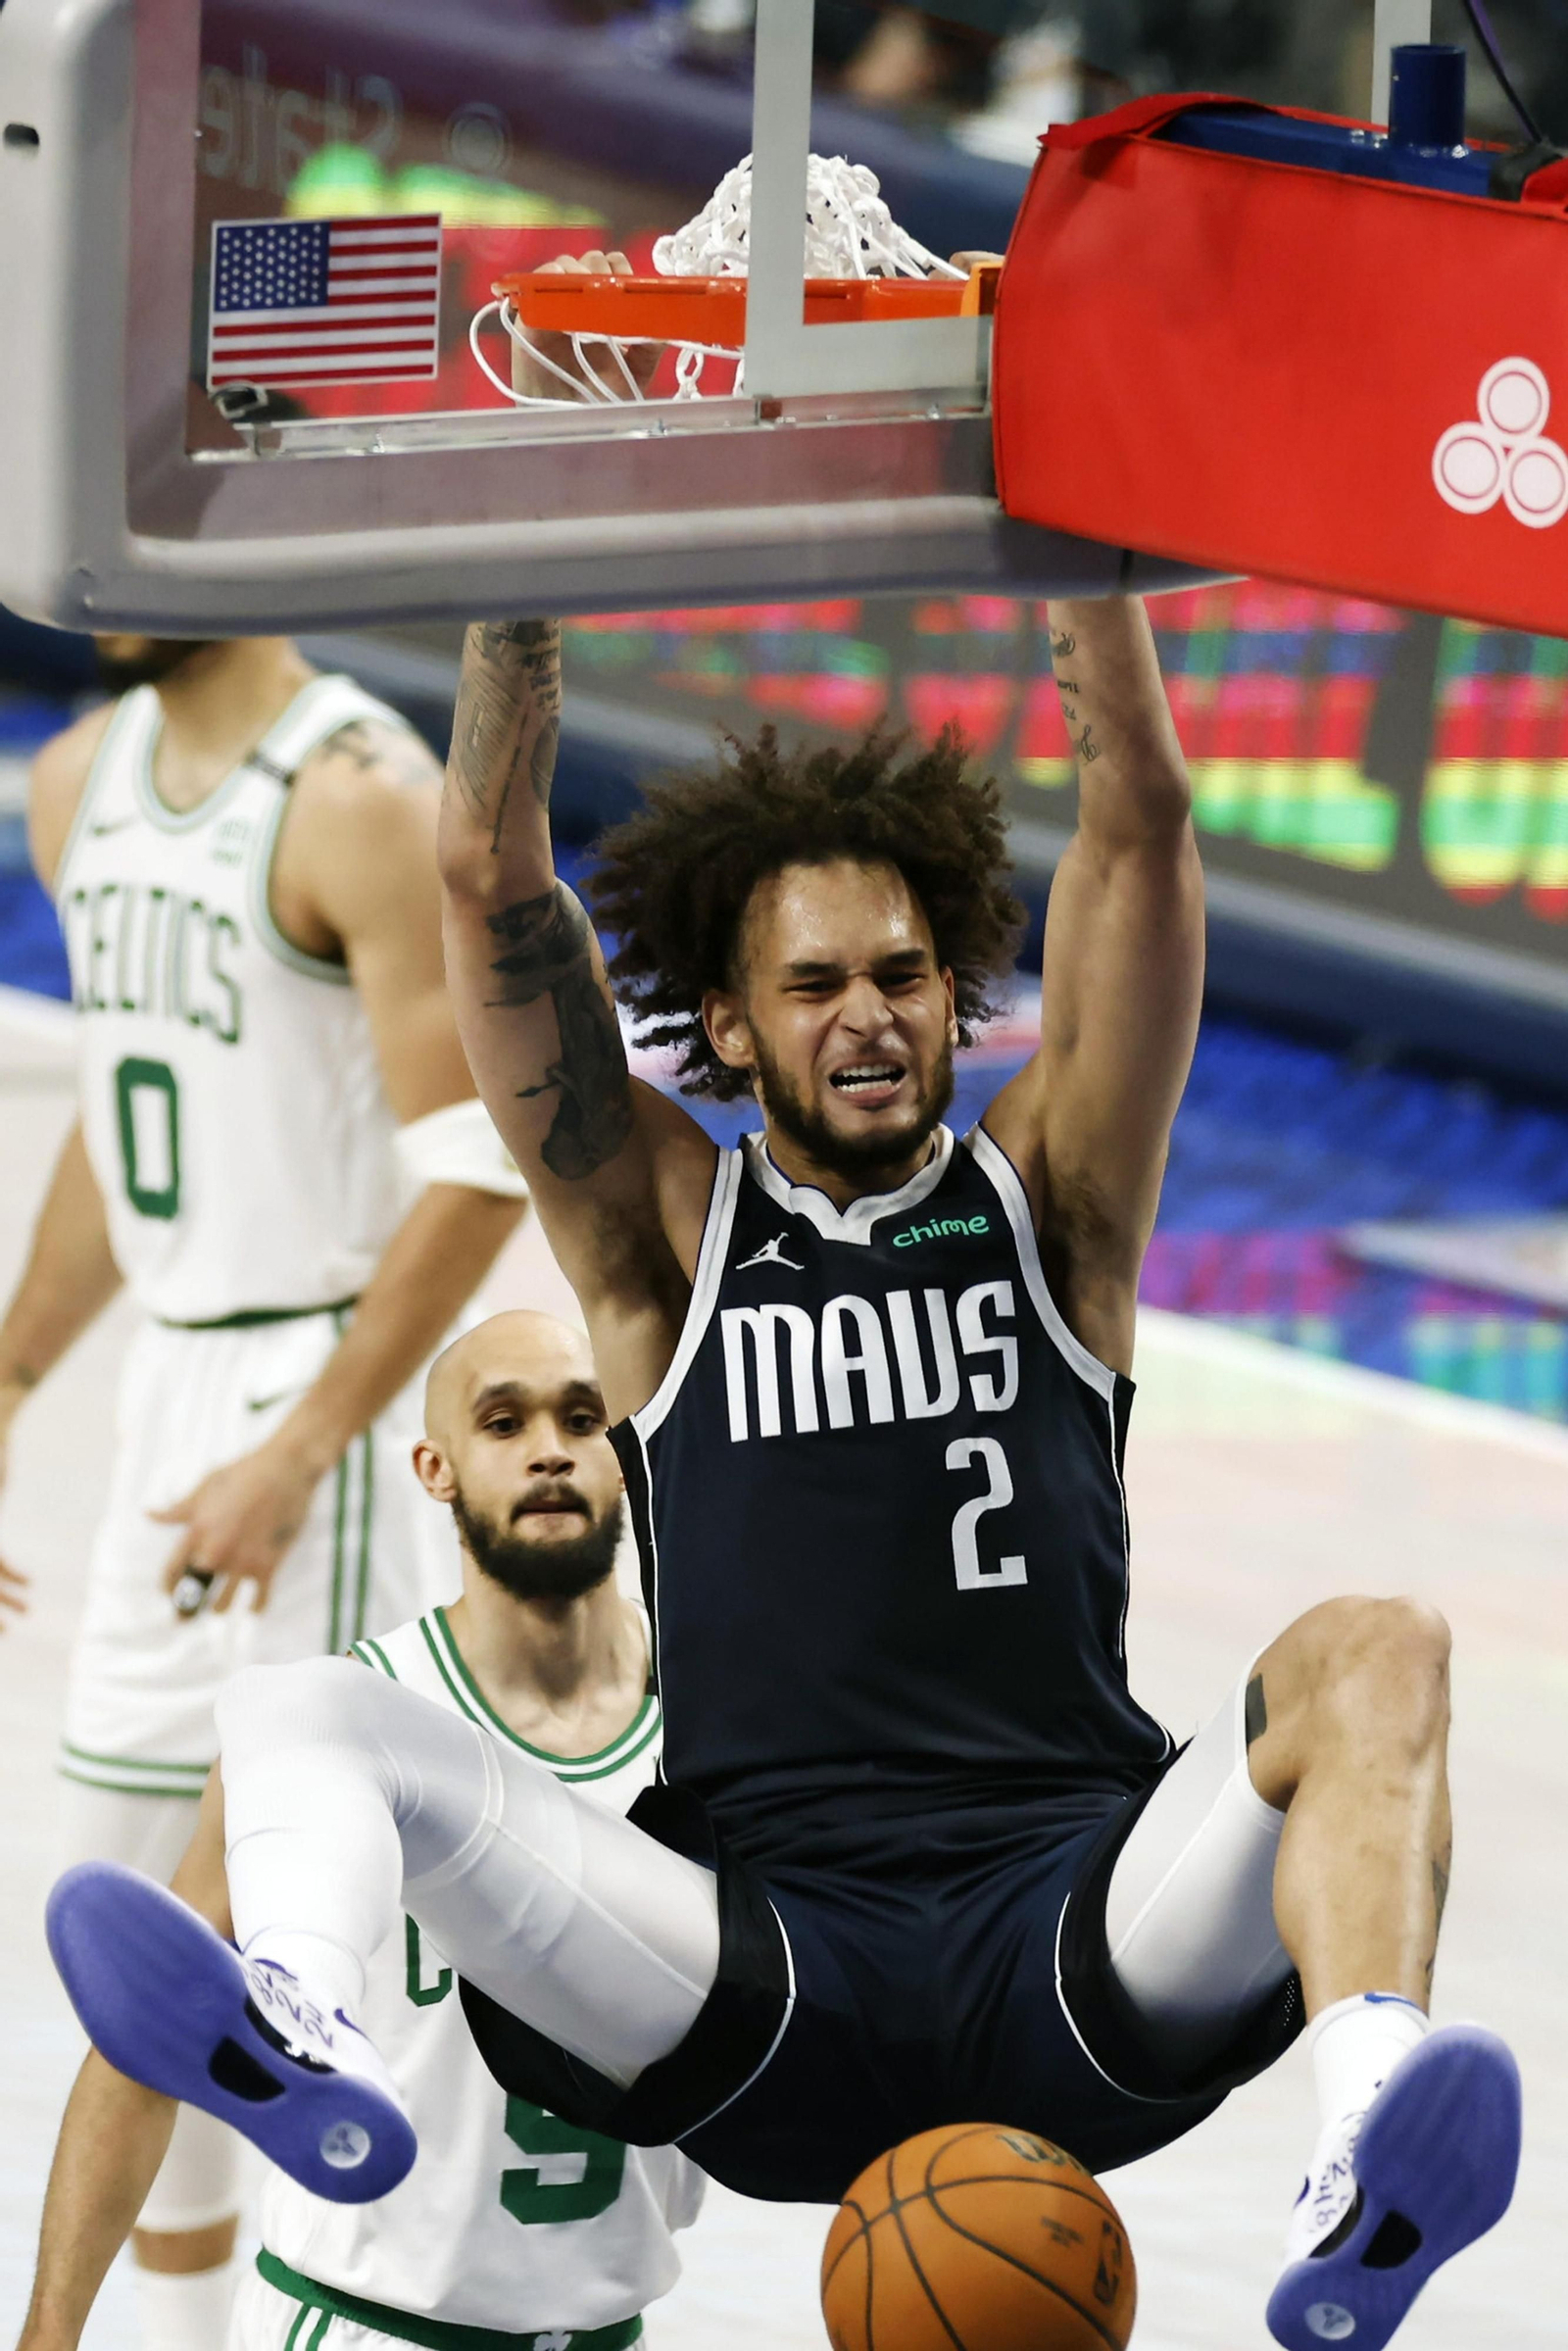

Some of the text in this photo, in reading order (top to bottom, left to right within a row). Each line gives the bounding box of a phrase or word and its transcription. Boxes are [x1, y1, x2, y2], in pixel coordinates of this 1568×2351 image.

[116, 1055, 179, 1219] 0
[892, 1214, 990, 1249] chime
[720, 1280, 1020, 1444] MAVS
[945, 1437, 1028, 1591] 2
